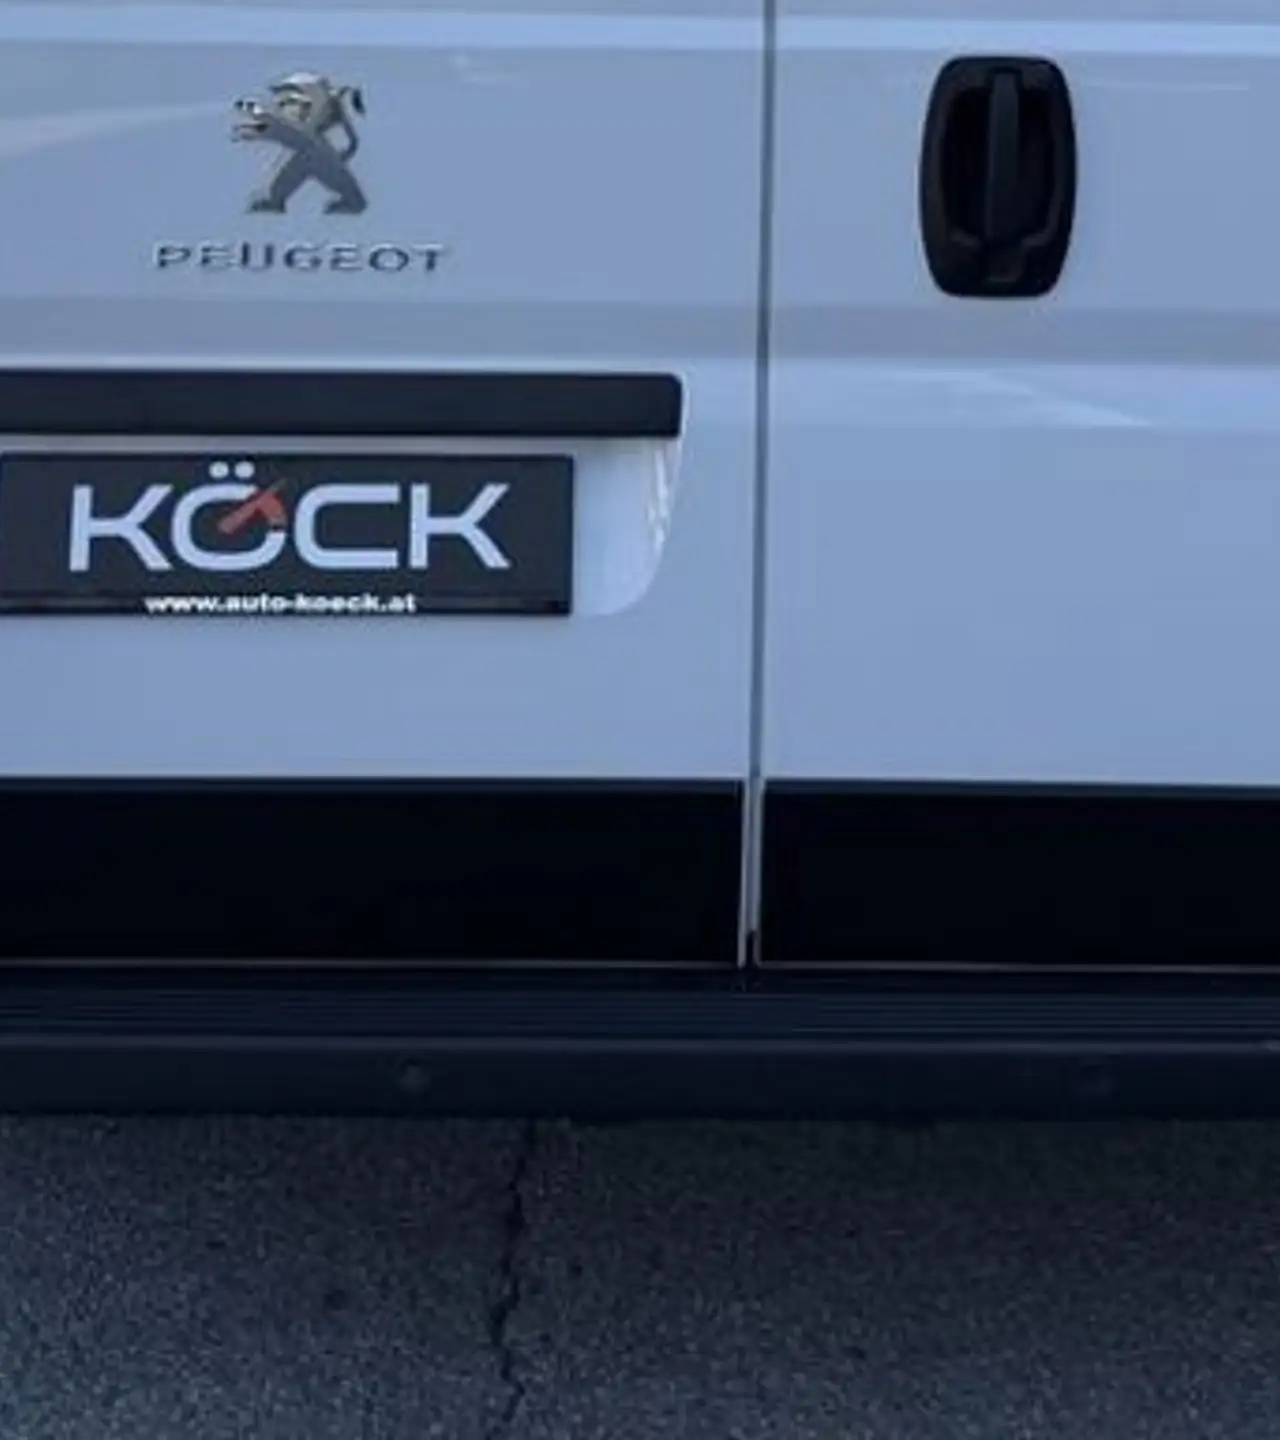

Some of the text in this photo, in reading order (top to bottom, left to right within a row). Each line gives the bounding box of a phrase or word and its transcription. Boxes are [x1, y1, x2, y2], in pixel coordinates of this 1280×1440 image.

[152, 240, 446, 272] PEUGEOT
[69, 460, 511, 572] KÖCK
[144, 591, 417, 614] www.auto-koeck.at
